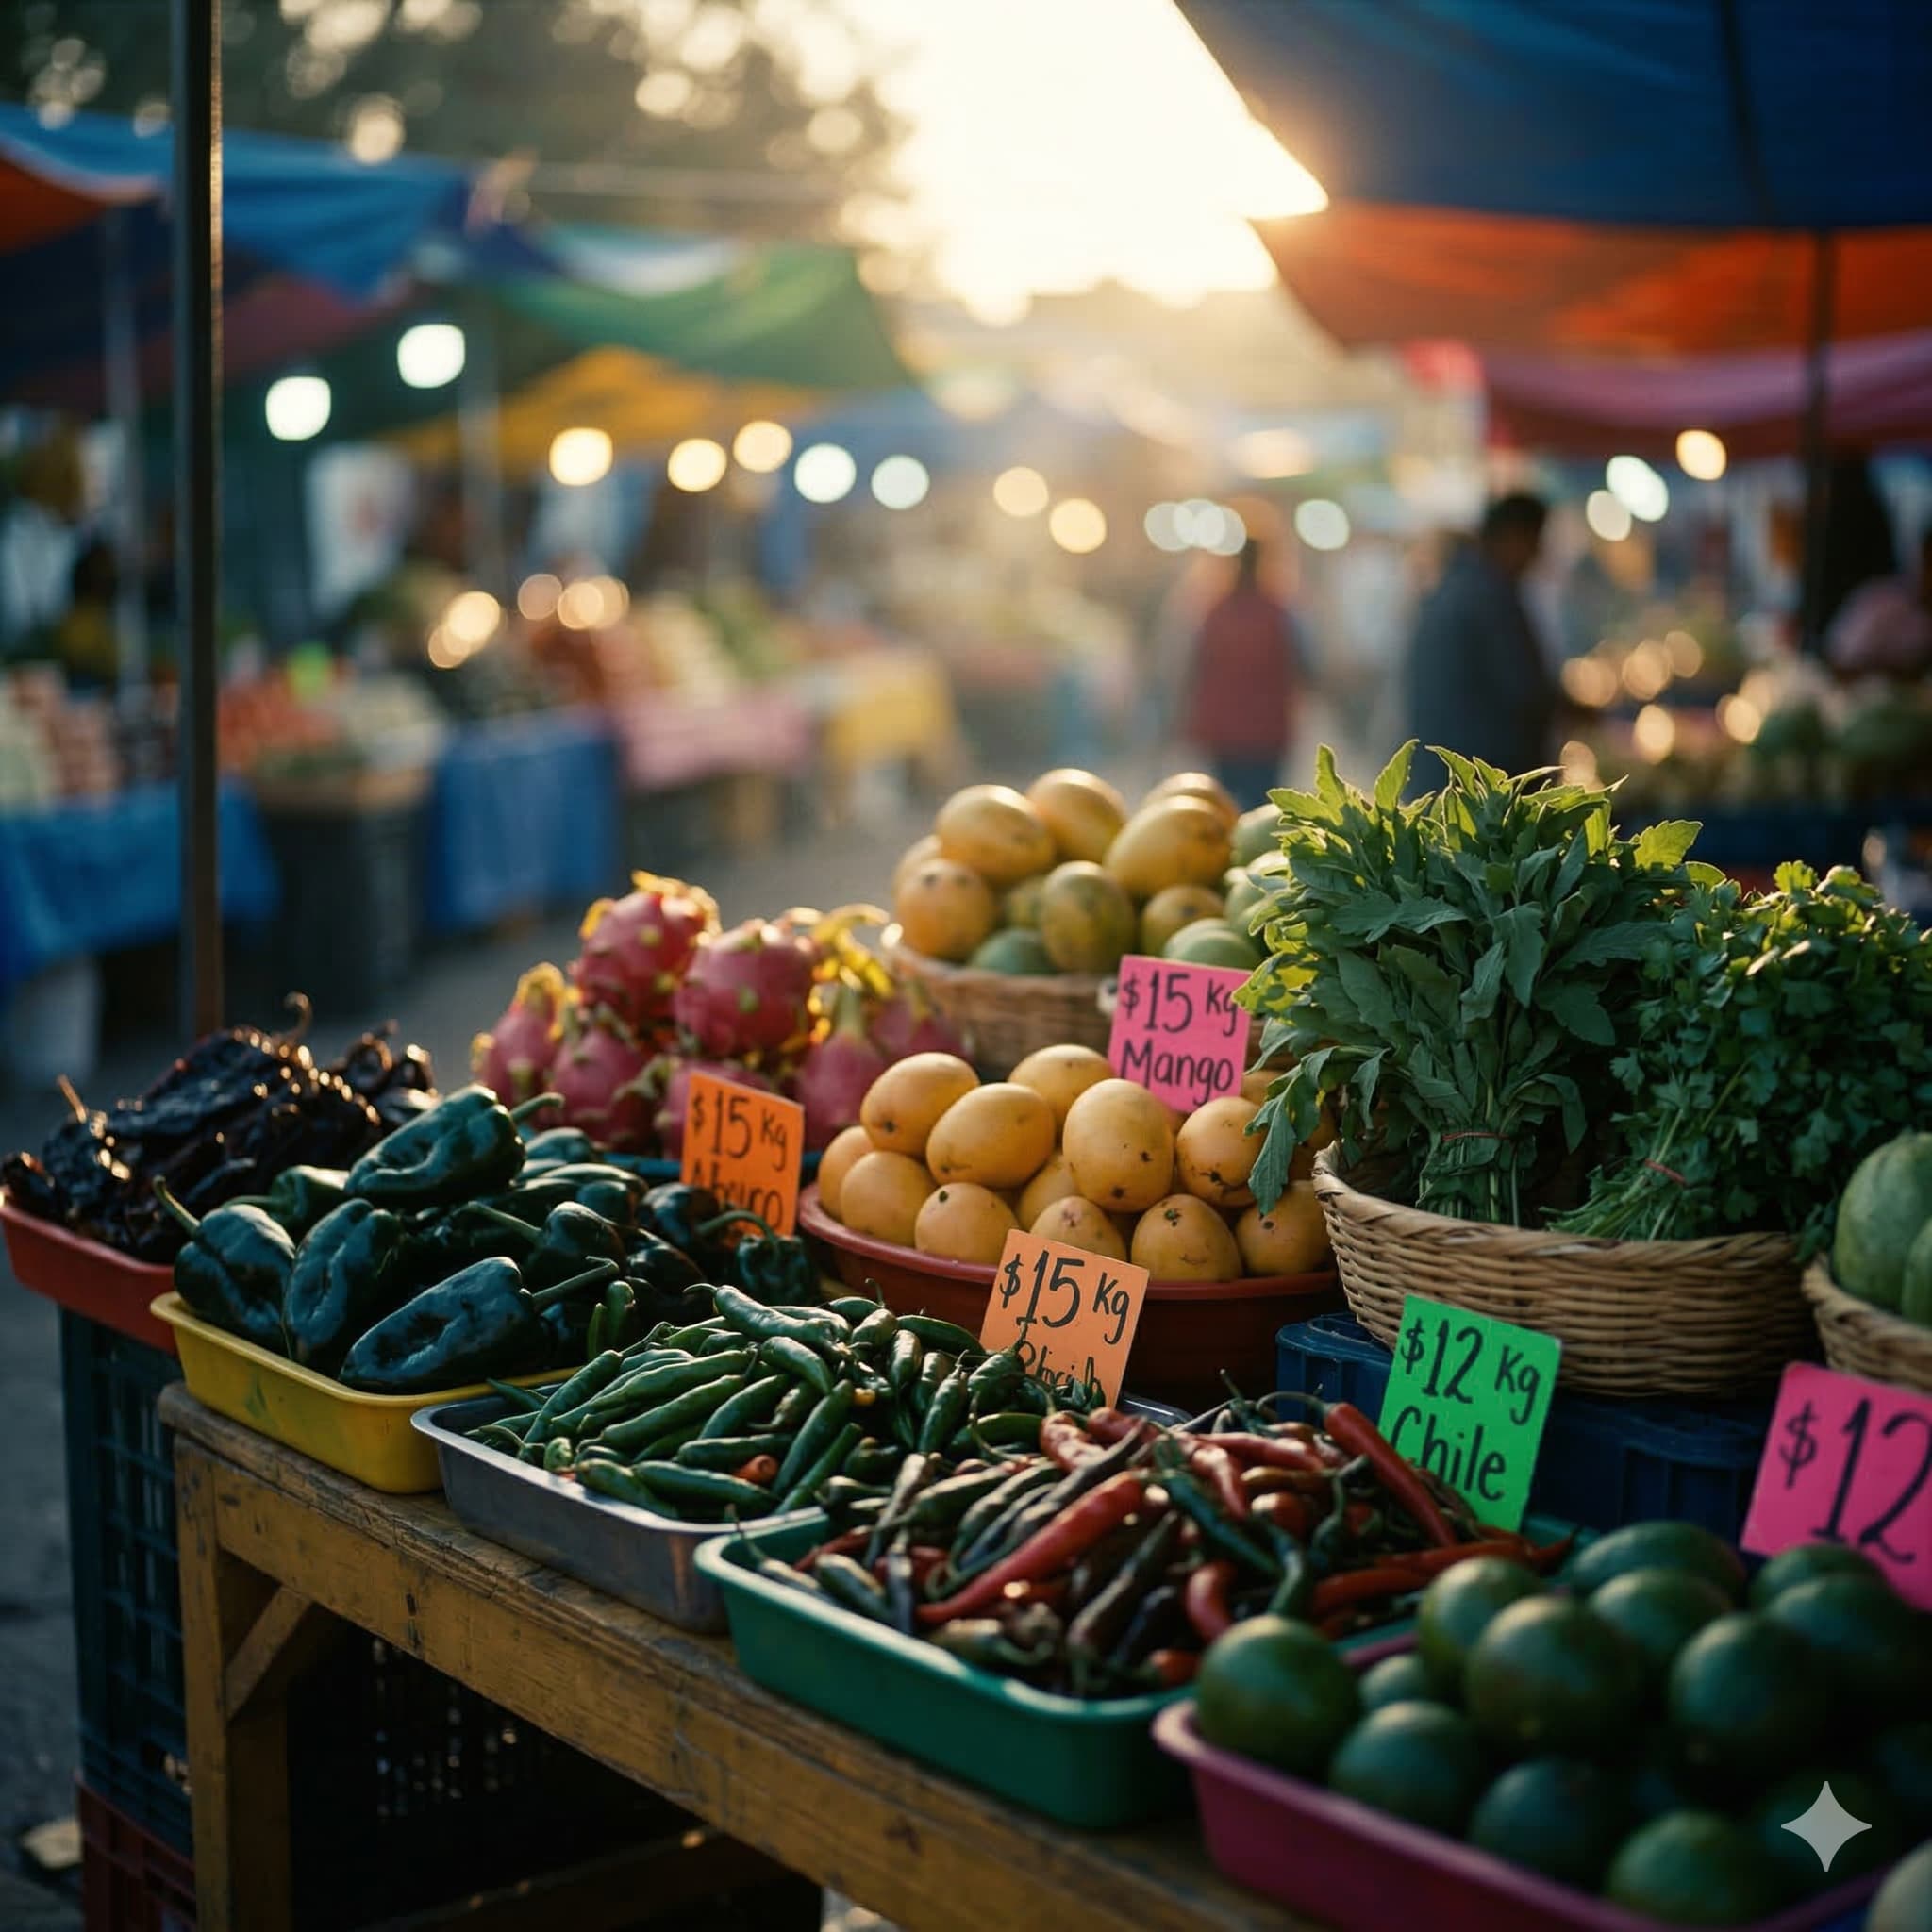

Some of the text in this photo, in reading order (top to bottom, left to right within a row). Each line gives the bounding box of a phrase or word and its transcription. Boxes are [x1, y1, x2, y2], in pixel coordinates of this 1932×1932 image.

[1122, 970, 1239, 1037] $15 Kg
[1120, 1038, 1234, 1106] Mango
[691, 1090, 787, 1172] $15 Kg
[999, 1250, 1130, 1344] $15 Kg
[1400, 1317, 1540, 1425] $12 Kg
[1390, 1405, 1507, 1501] Chile
